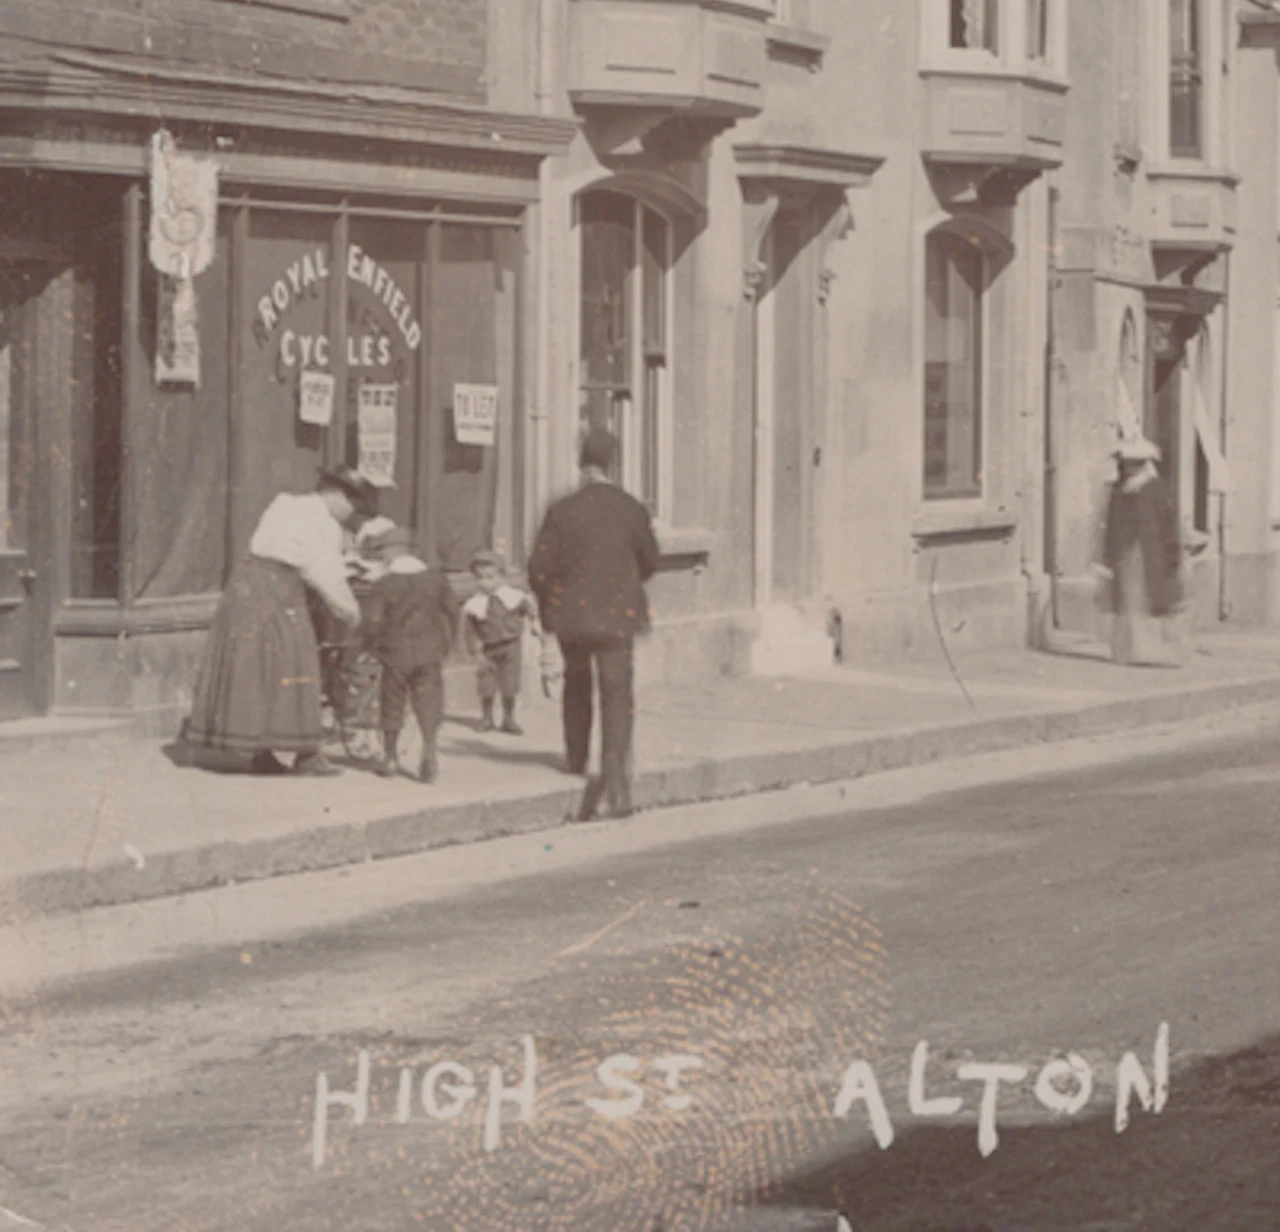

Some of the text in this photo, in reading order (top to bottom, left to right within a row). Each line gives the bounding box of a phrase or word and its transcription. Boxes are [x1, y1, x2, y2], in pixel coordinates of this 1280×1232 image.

[257, 244, 423, 351] ROYAL ENFIELD
[279, 329, 392, 368] CYCLES
